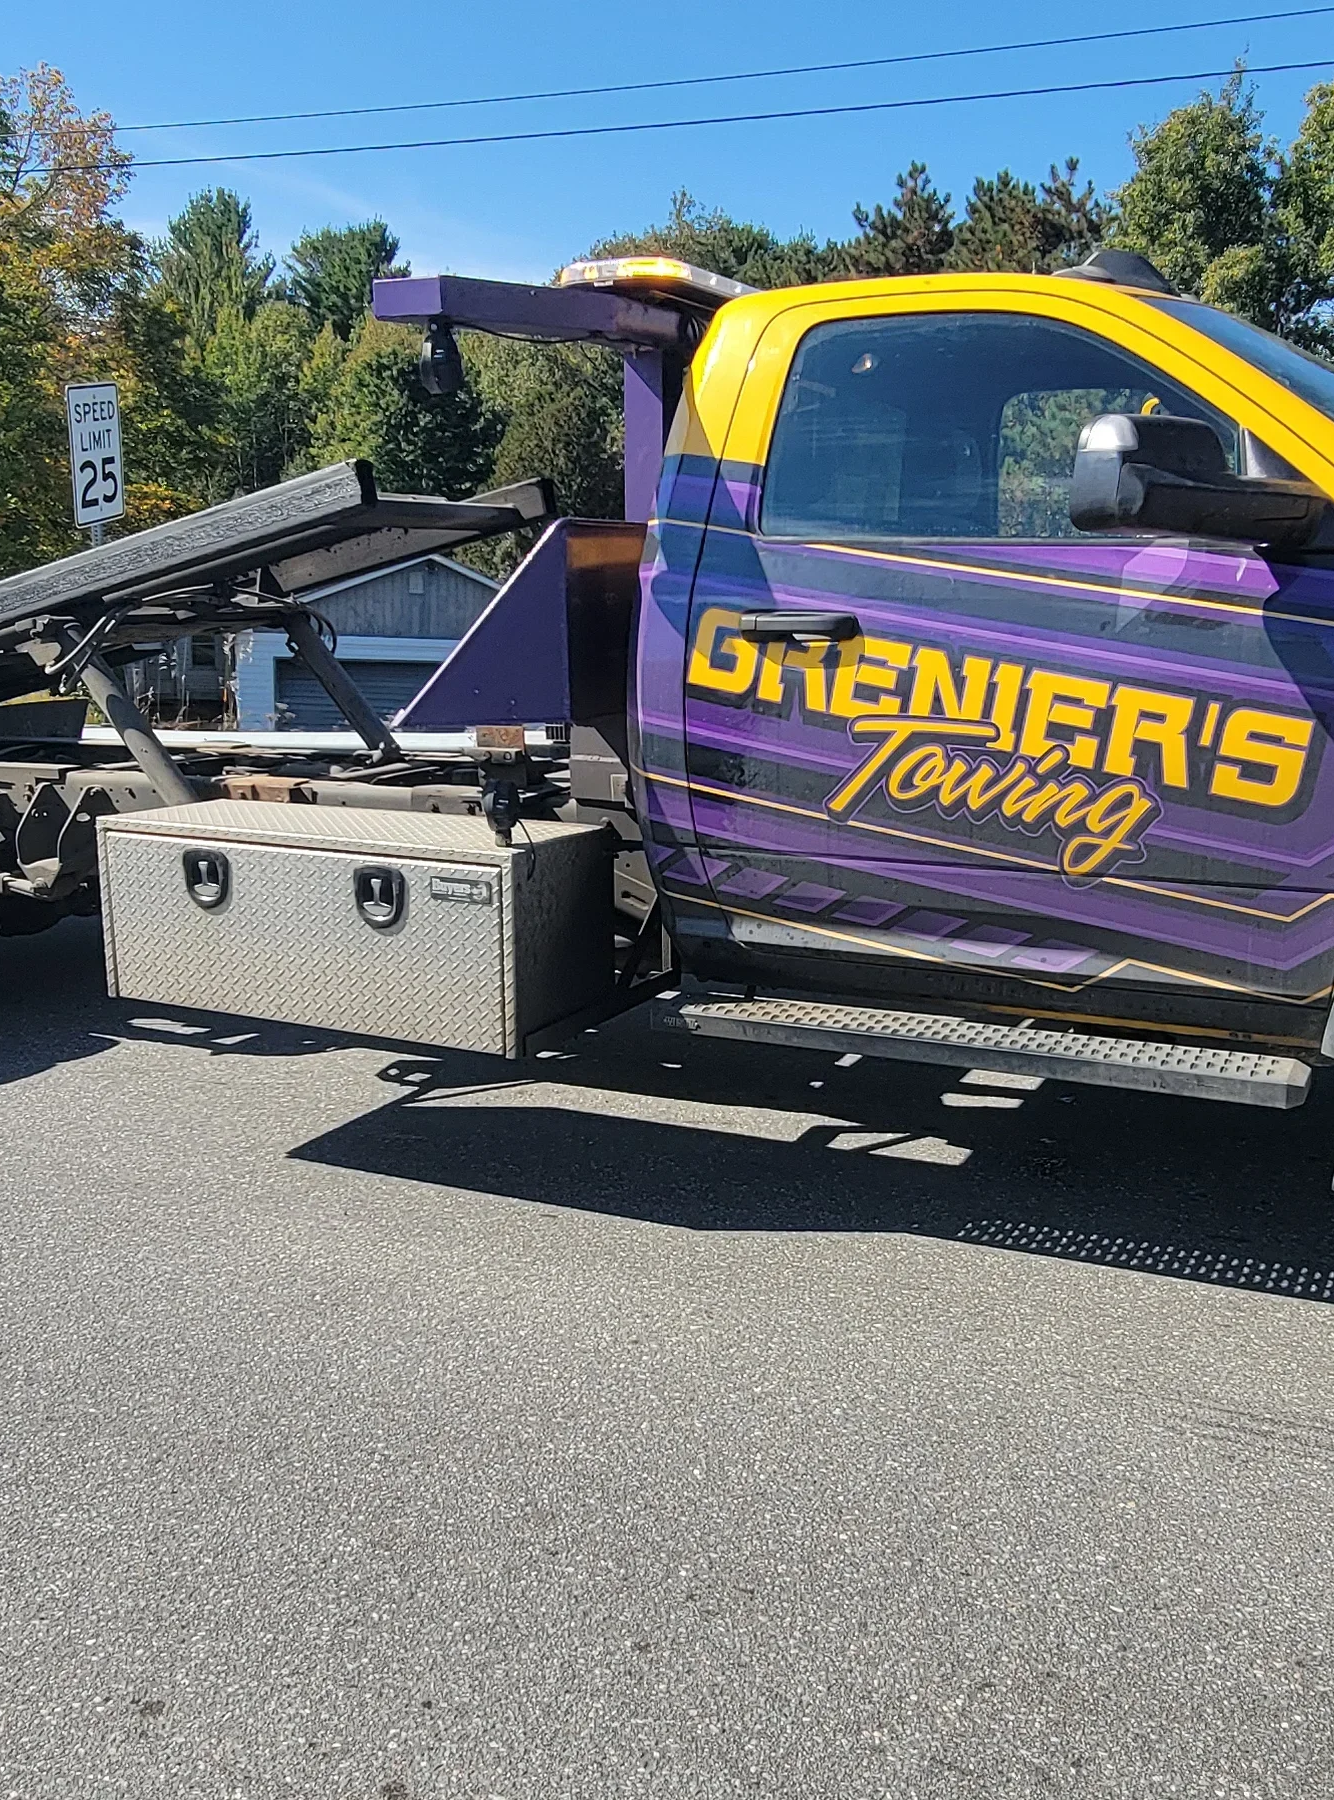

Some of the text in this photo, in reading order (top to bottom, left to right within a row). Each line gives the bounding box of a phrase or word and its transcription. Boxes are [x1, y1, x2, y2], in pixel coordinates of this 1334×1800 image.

[74, 400, 115, 423] SPEED
[79, 429, 112, 452] LIMIT
[79, 456, 118, 509] 25
[687, 606, 1315, 808] GRENIER'S
[826, 716, 1155, 876] Towing
[431, 878, 471, 895] Buyers
